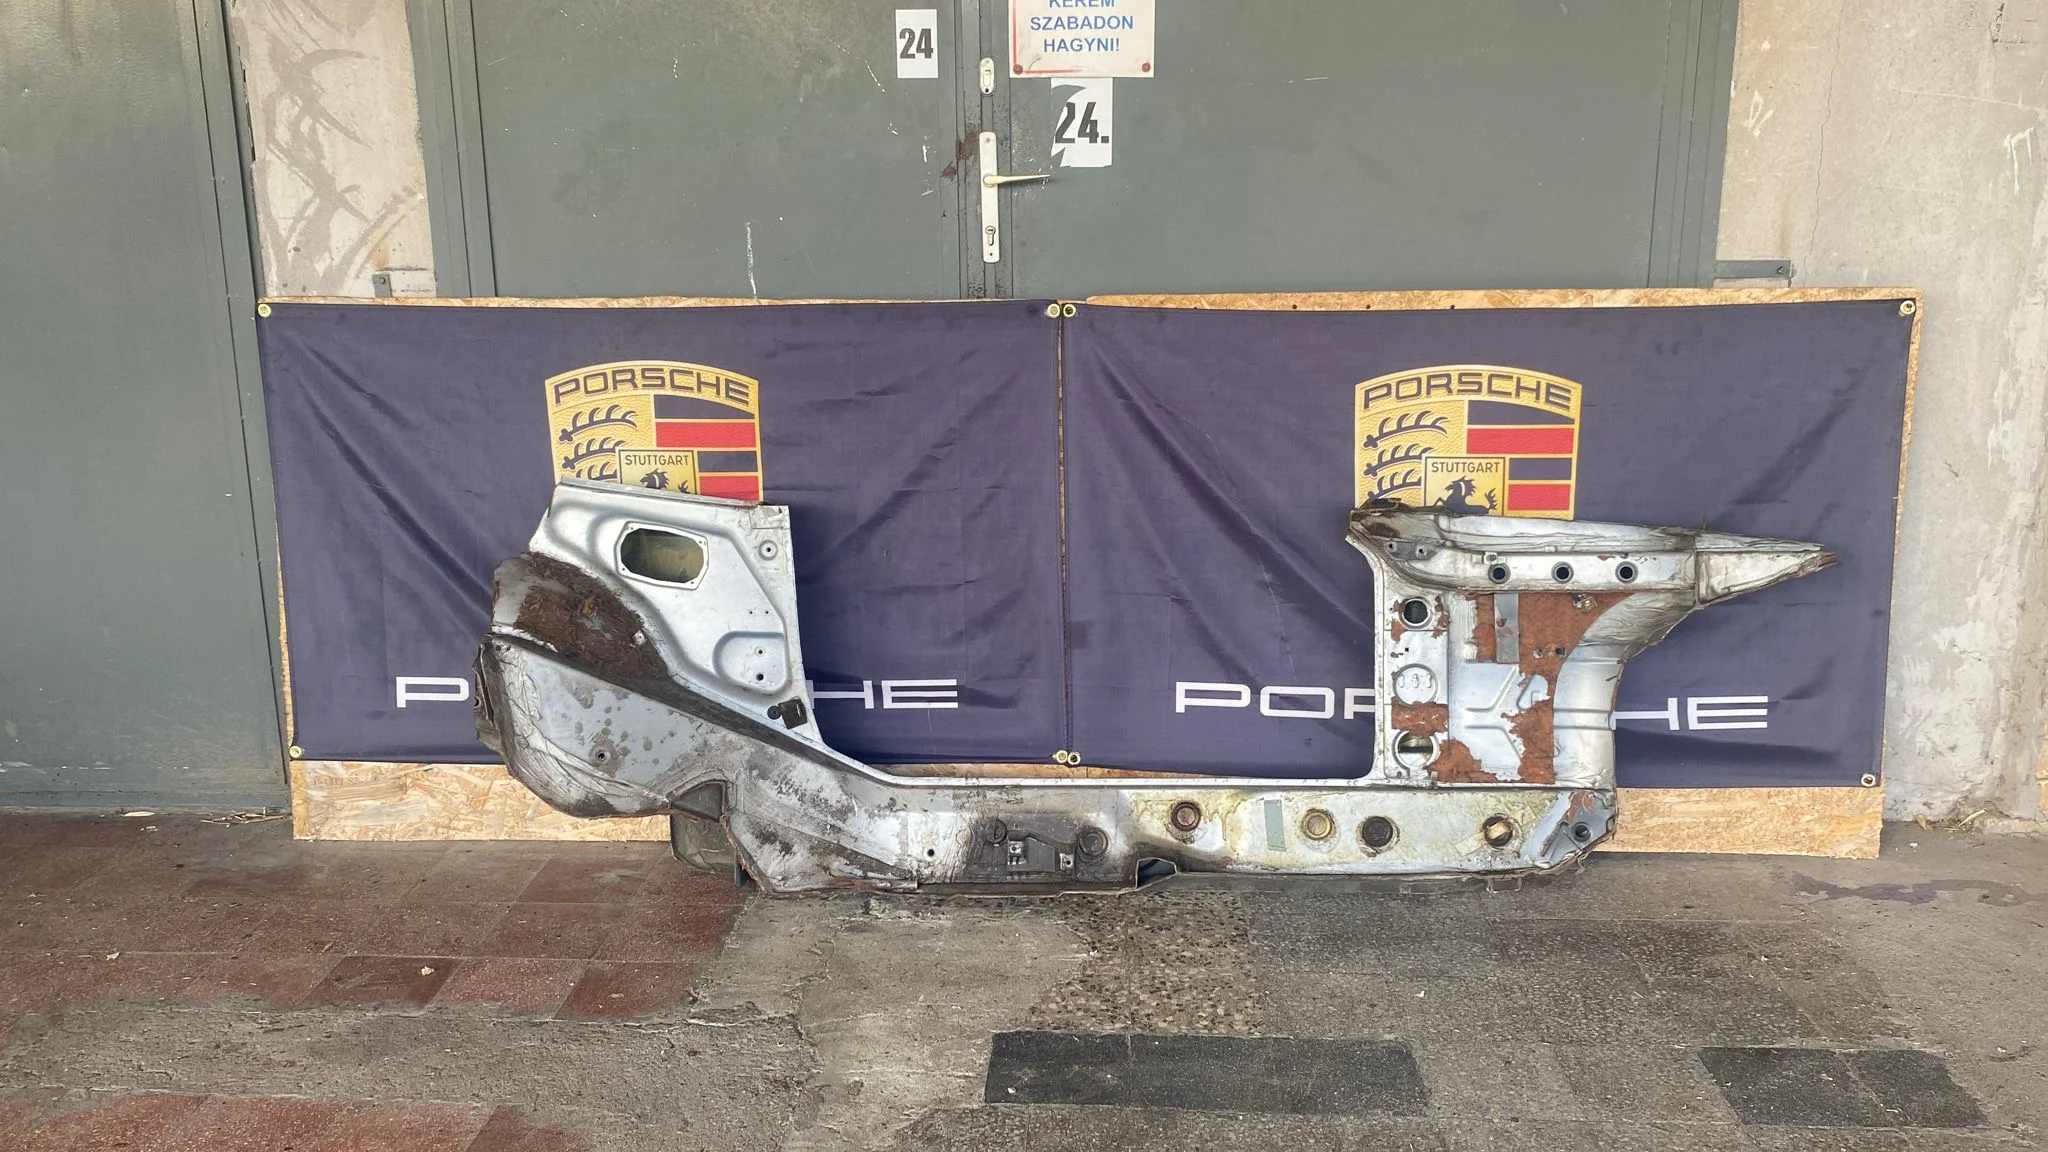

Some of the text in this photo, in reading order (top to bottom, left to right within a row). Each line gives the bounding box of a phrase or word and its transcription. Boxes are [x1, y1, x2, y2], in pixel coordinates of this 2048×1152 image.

[1030, 15, 1134, 31] SZABADON
[899, 28, 934, 59] 24
[1043, 37, 1120, 52] HAGYNI!
[1054, 101, 1110, 145] 24.
[553, 367, 750, 406] PORSCHE
[1363, 372, 1572, 410] PORSCHE
[625, 454, 689, 467] STUTTGART
[1431, 461, 1500, 474] STUTTGART
